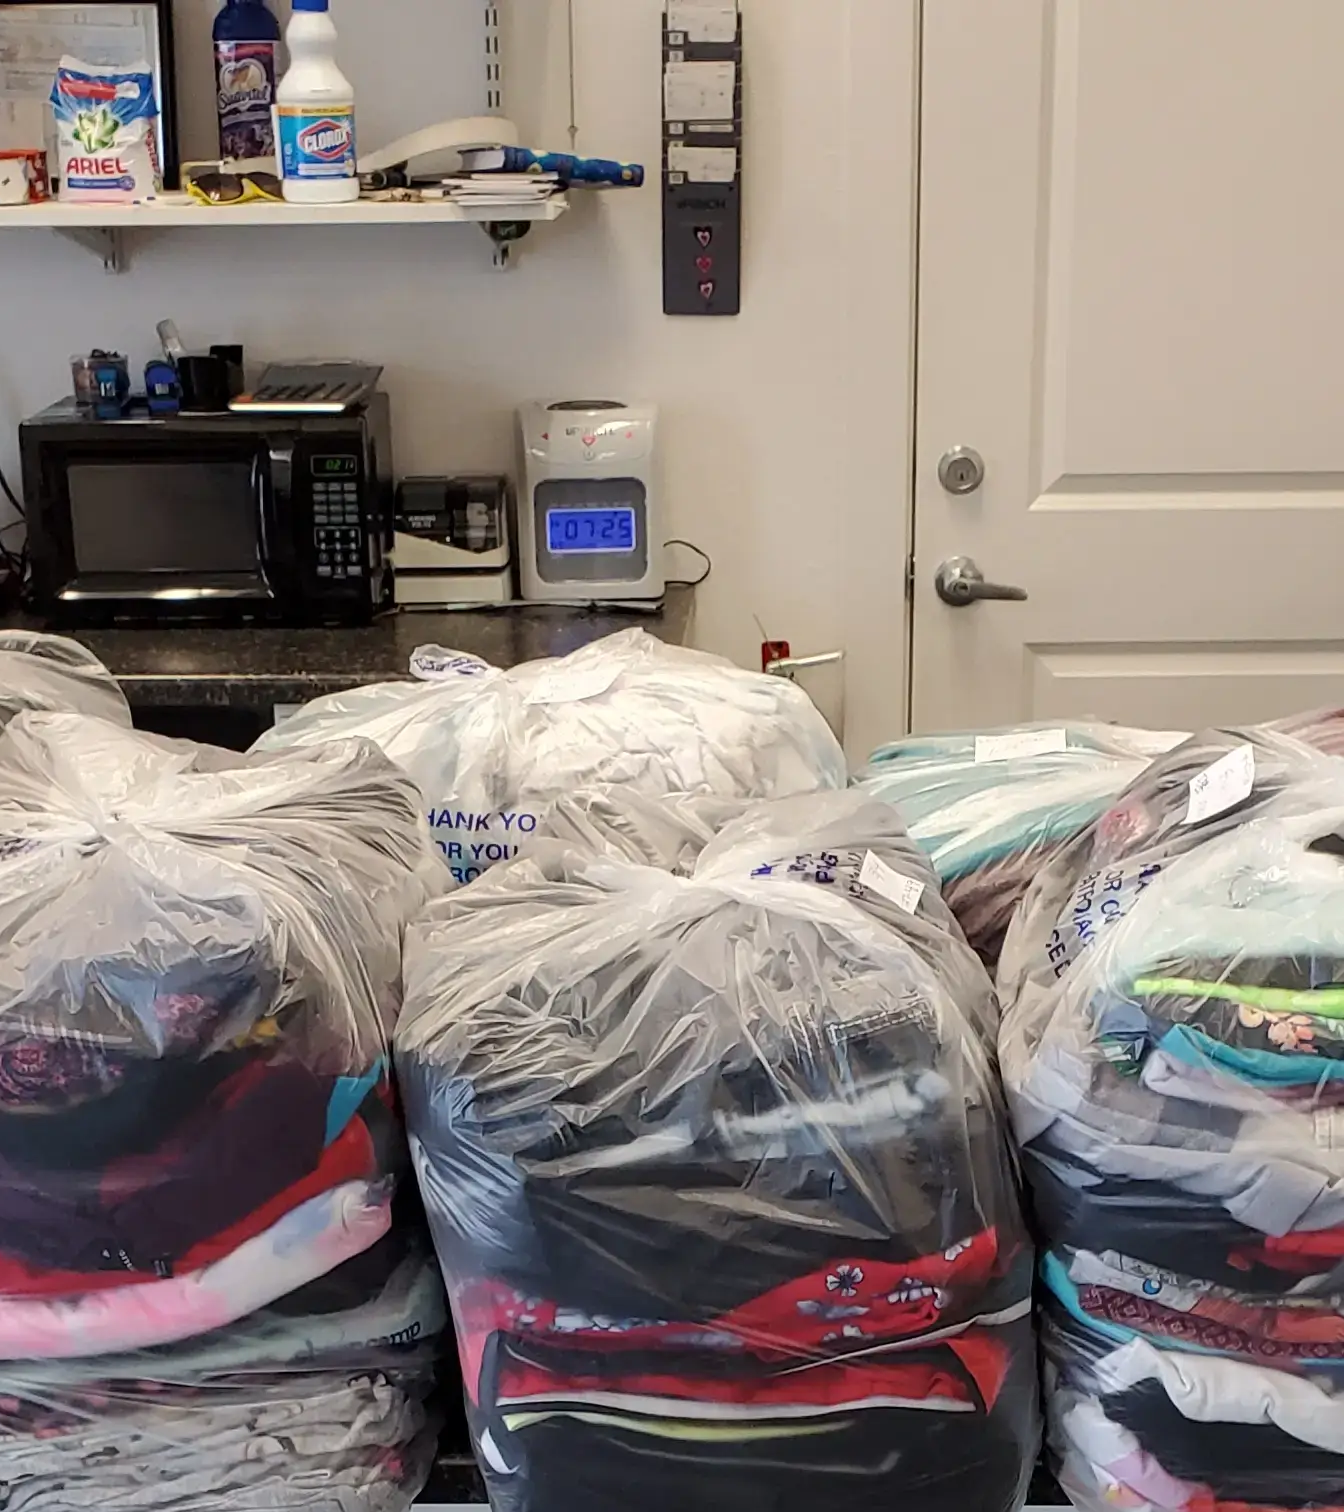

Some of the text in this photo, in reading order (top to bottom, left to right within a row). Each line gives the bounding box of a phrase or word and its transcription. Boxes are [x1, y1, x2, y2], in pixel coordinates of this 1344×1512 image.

[304, 127, 348, 152] CLOROX
[66, 157, 129, 175] ARIEL
[427, 807, 544, 833] HANK YO
[435, 840, 463, 860] OR
